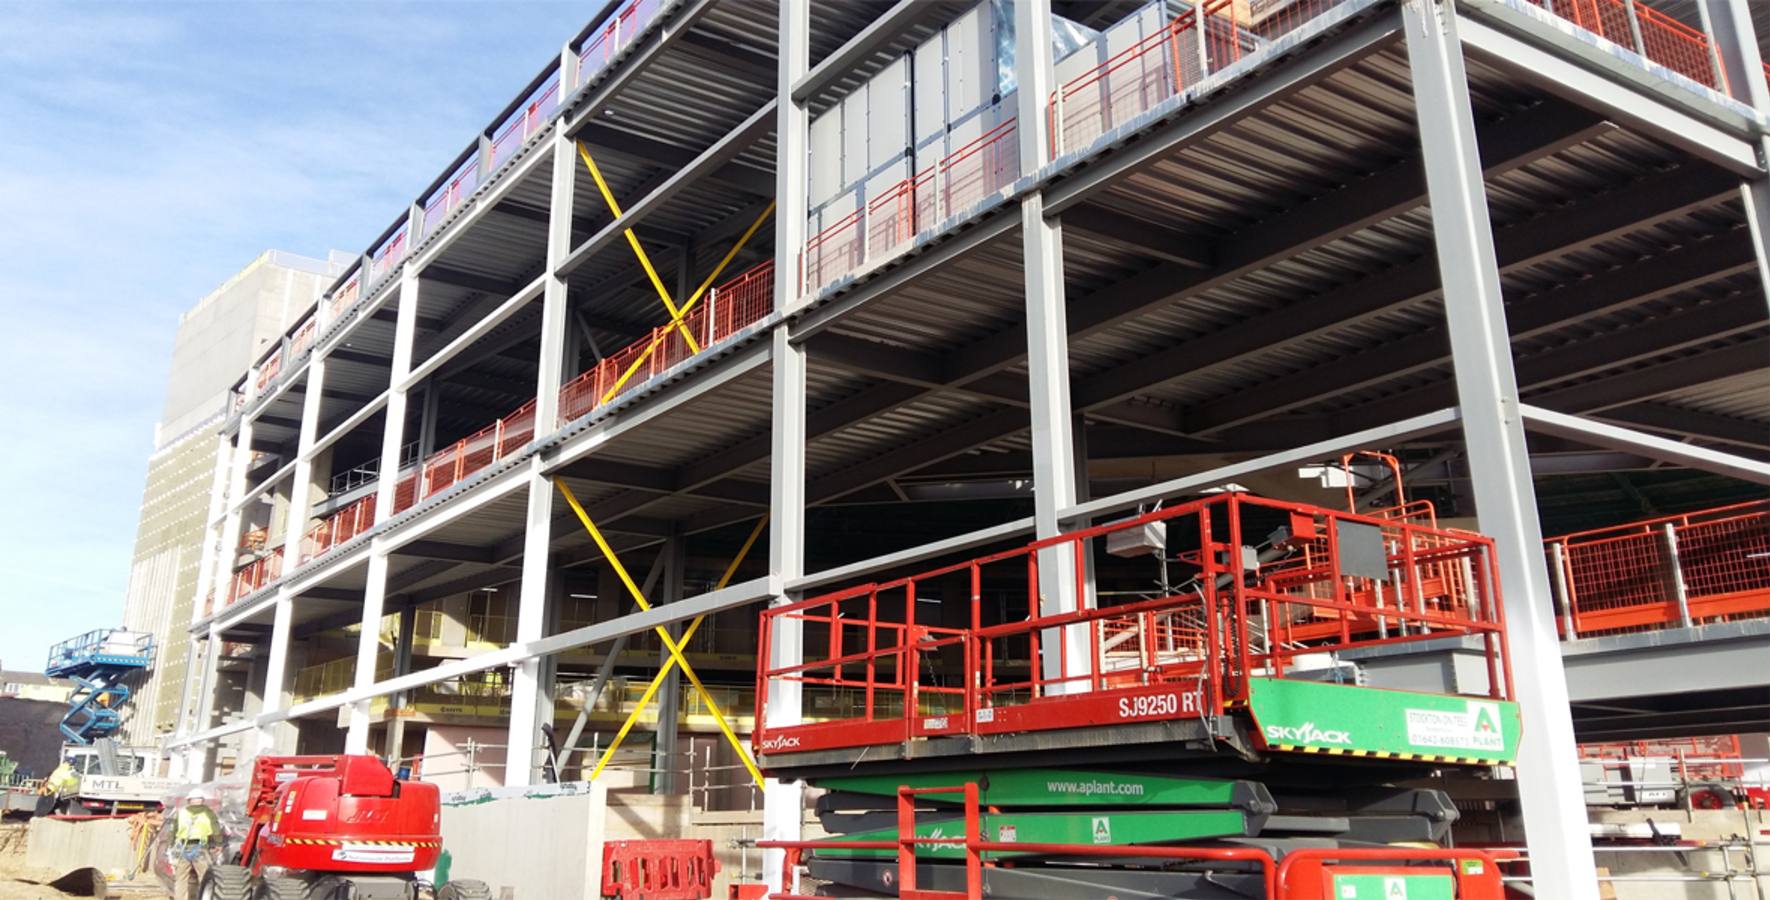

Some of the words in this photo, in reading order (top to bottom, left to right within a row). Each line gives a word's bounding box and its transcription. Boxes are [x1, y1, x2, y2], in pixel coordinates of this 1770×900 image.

[1119, 693, 1178, 717] SJ9250
[762, 734, 801, 750] SKYJACK
[1266, 721, 1352, 744] SKYJACK
[1047, 779, 1145, 796] www.aplant.com
